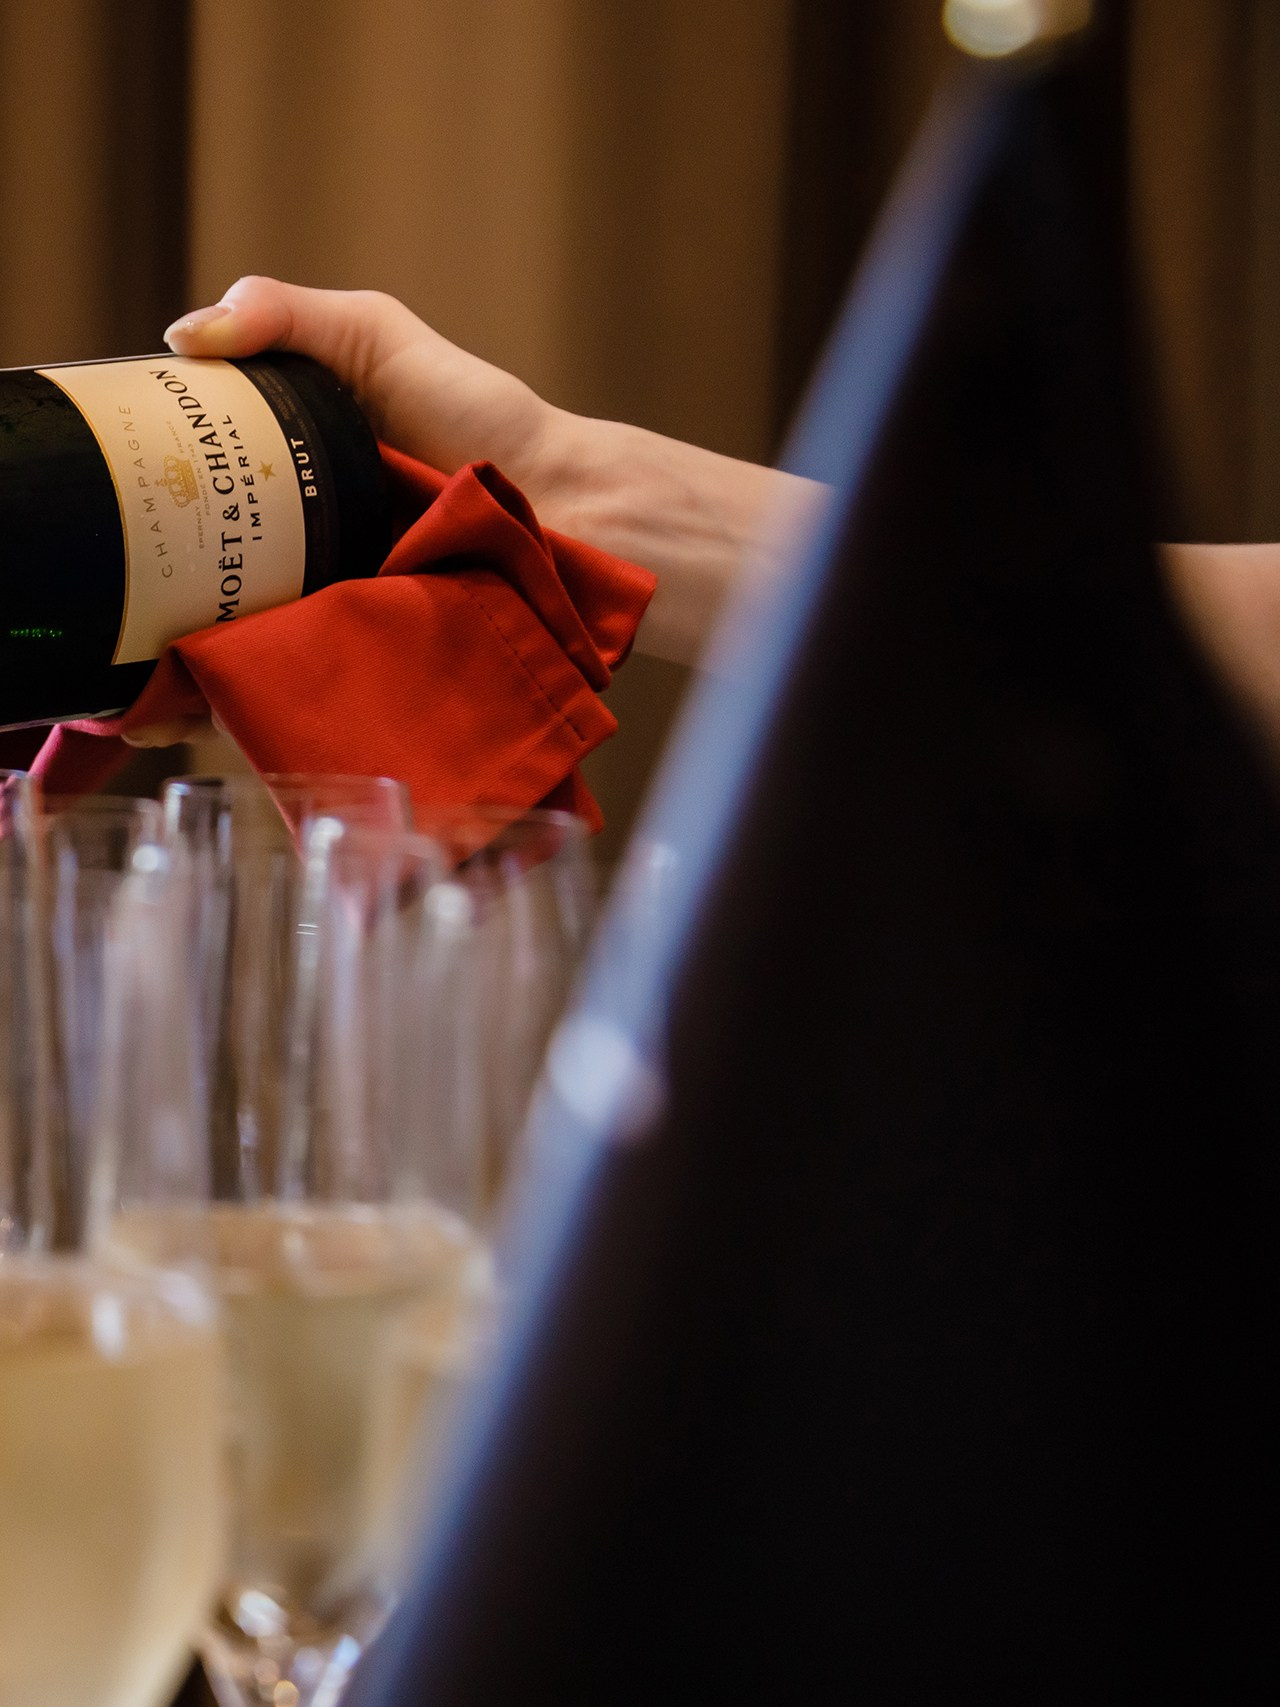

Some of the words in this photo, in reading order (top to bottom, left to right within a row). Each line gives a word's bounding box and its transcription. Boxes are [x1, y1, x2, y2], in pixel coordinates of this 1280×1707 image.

[149, 368, 235, 495] CHANDON
[222, 414, 263, 540] IMPÉRIAL
[290, 438, 318, 497] BRUT
[118, 405, 173, 578] CHAMPAGNE
[222, 502, 240, 521] &
[215, 531, 243, 624] MOËT
